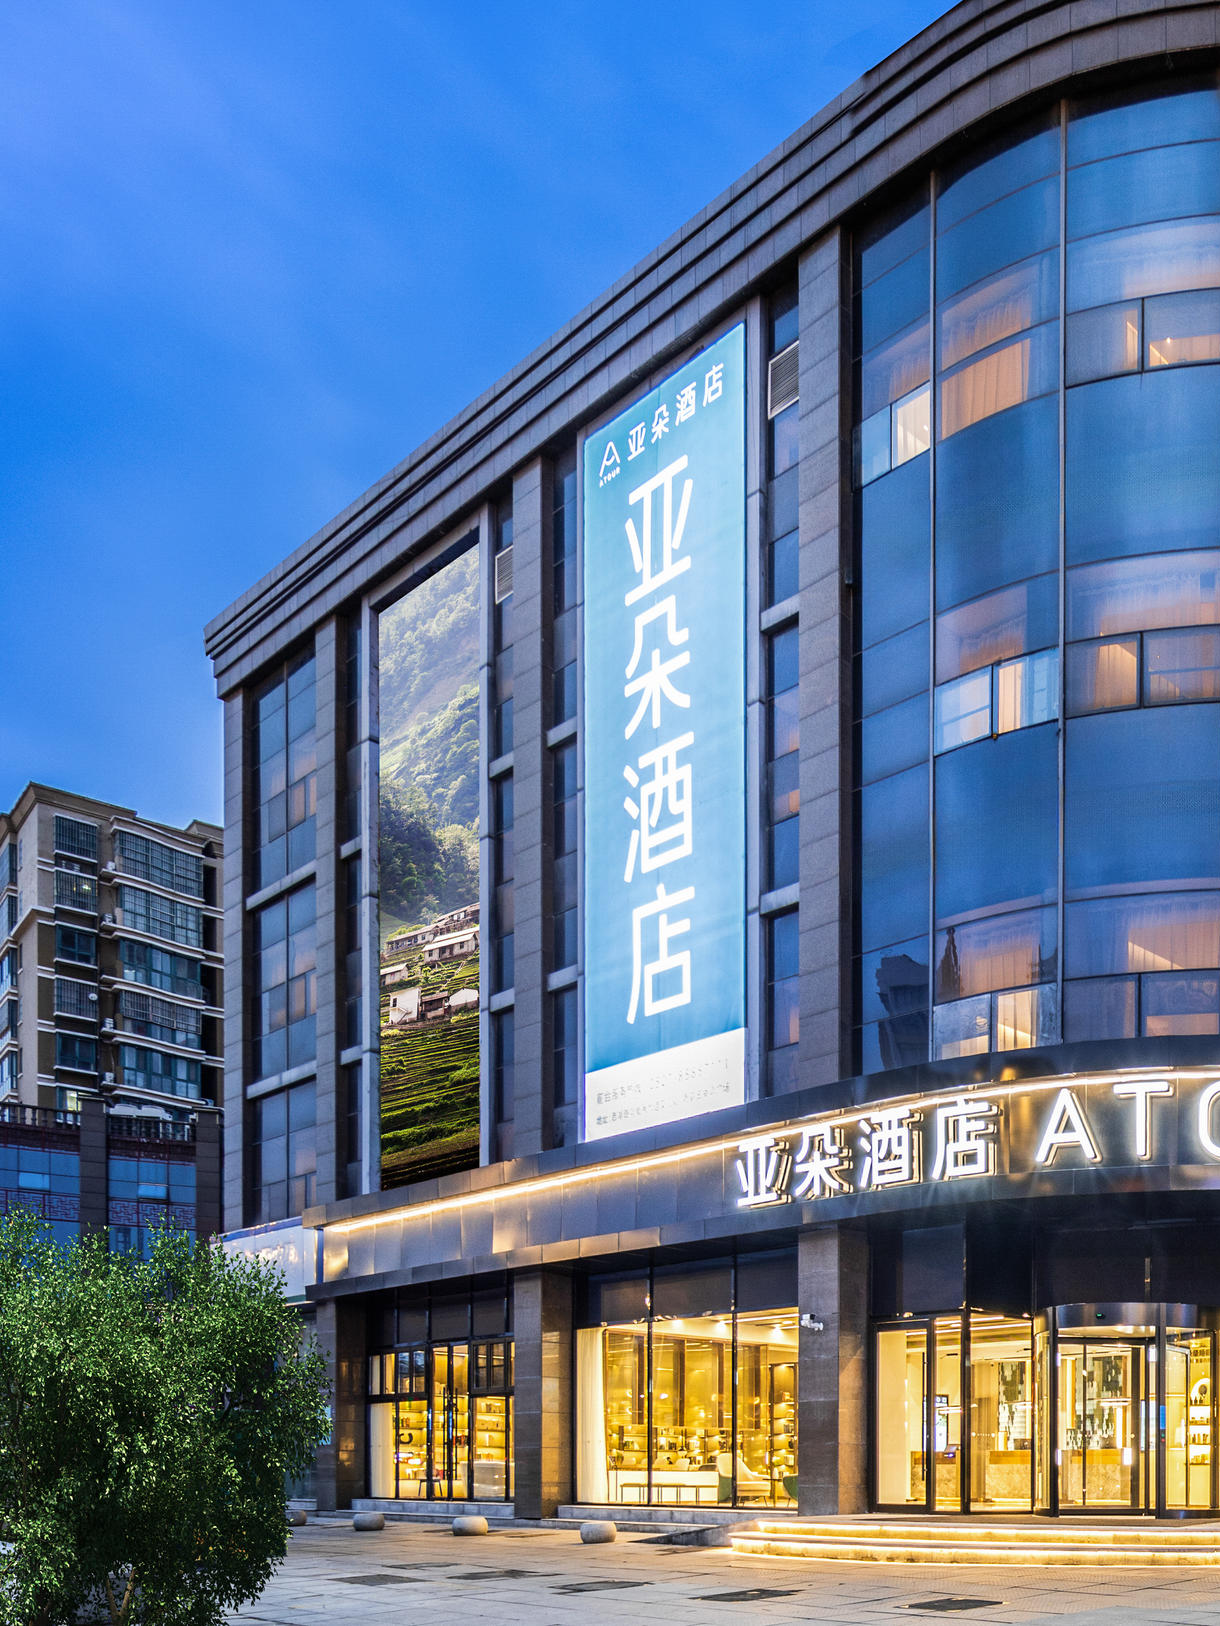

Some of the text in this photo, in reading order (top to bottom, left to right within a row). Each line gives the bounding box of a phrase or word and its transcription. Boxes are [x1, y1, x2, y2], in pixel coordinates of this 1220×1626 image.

[627, 363, 724, 461] 亚朵酒店
[599, 466, 621, 488] ATOUR
[623, 454, 695, 1024] 亚朵酒店
[735, 1098, 998, 1207] 亚朵酒店
